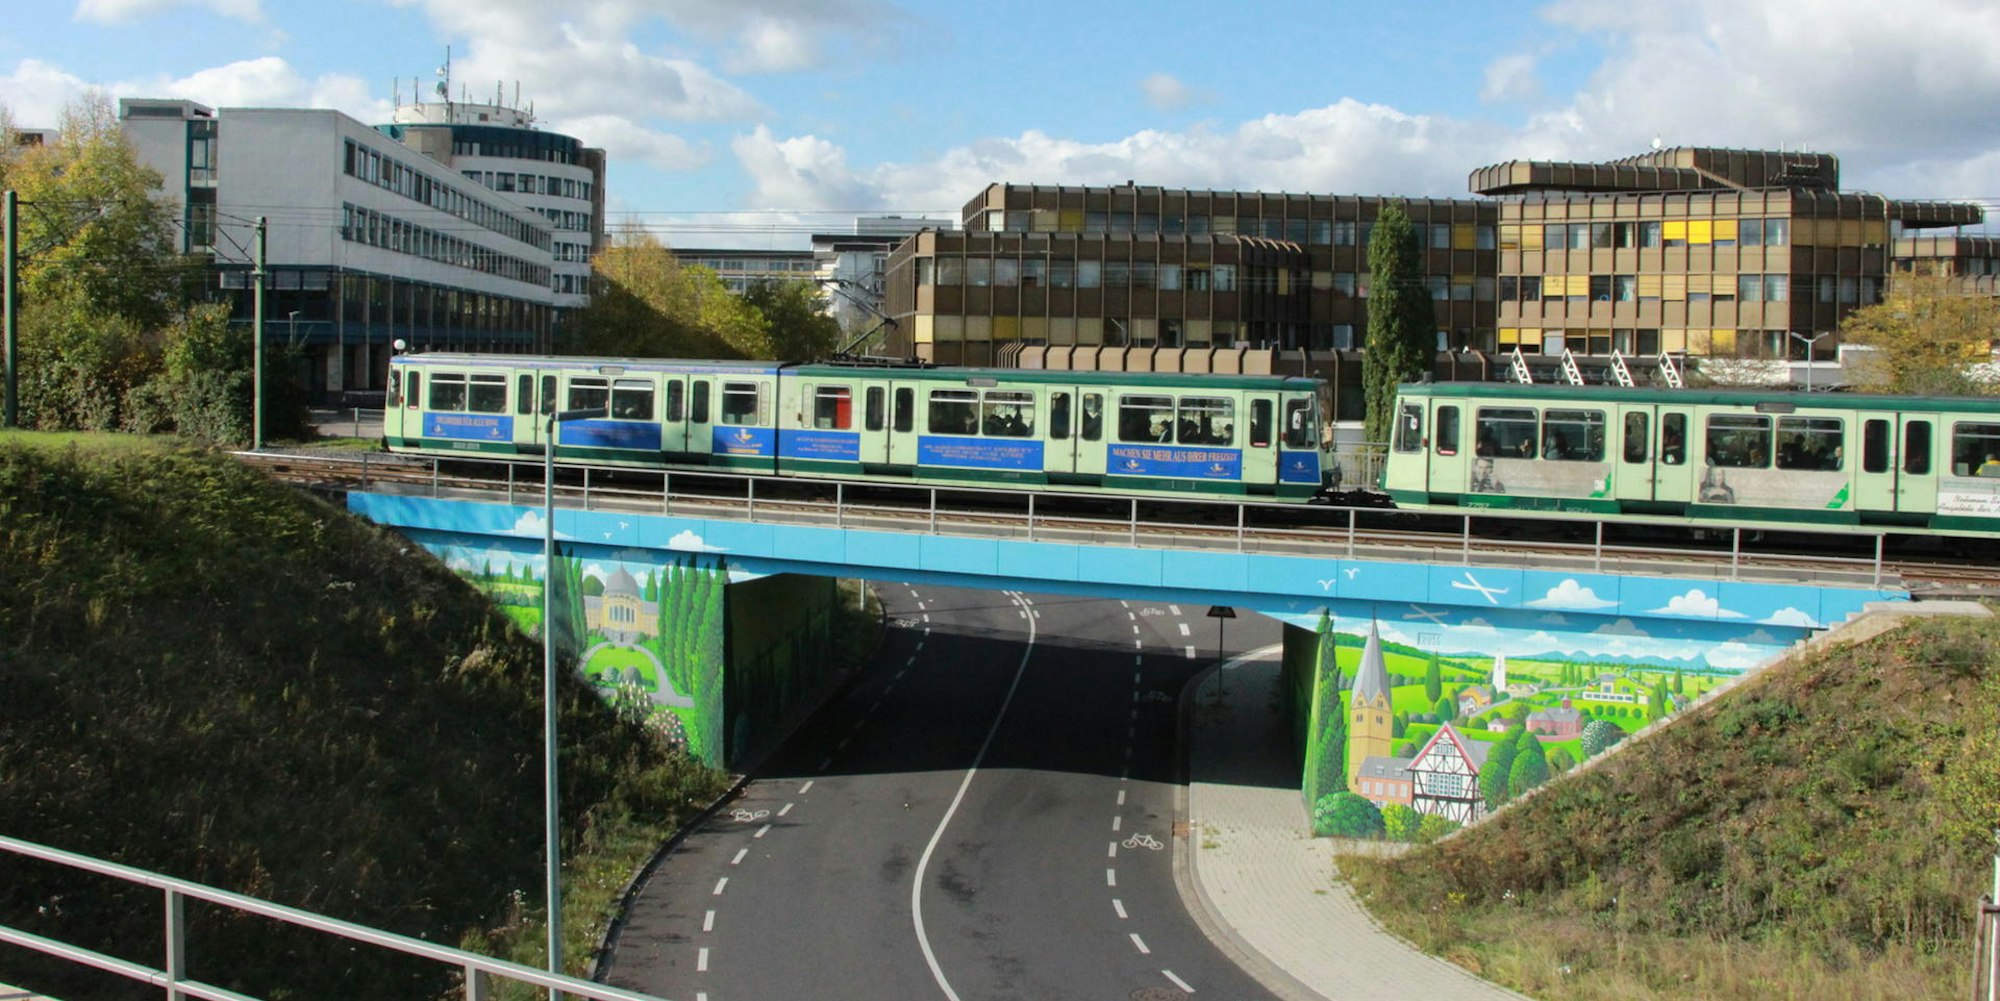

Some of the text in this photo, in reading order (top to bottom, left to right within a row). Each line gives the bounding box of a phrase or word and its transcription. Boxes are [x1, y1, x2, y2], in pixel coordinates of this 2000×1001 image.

[1112, 448, 1140, 458] MACHEN
[1141, 449, 1152, 460] SIE
[1153, 450, 1172, 461] MEHR
[1173, 451, 1187, 462] AUS
